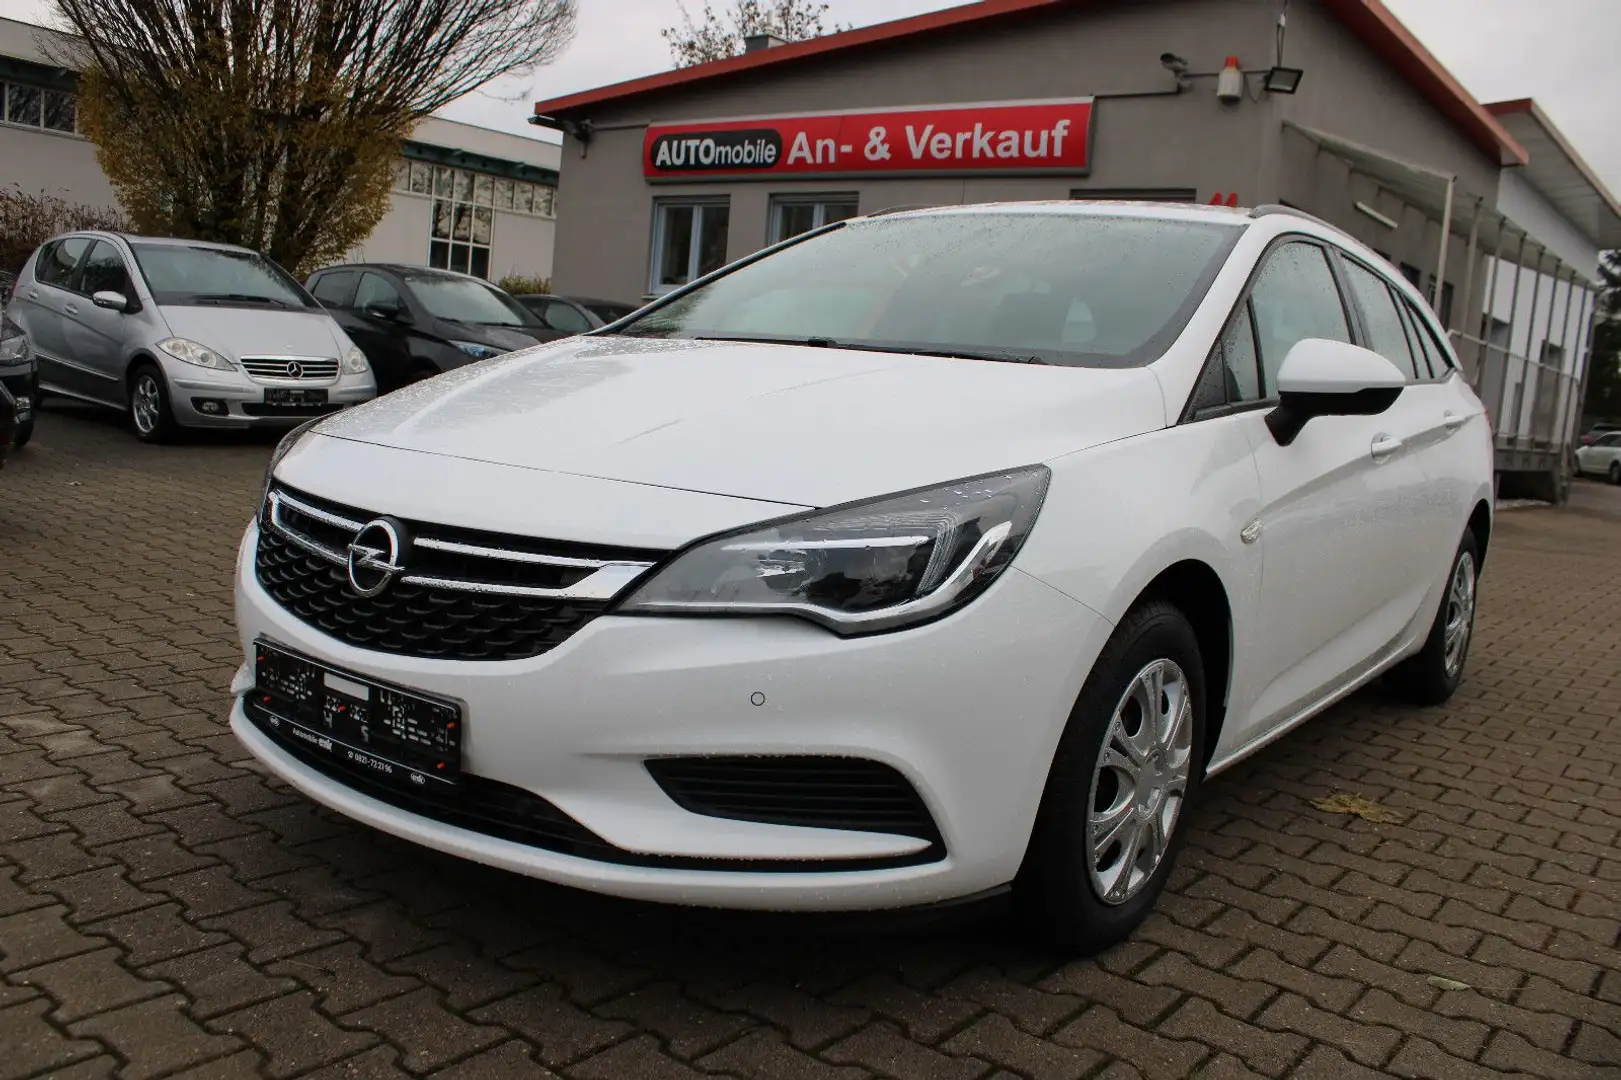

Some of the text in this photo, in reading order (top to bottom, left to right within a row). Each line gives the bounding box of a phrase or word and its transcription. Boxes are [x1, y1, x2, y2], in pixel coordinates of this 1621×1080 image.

[655, 119, 1071, 166] AUTOmobile An- & Verkauf
